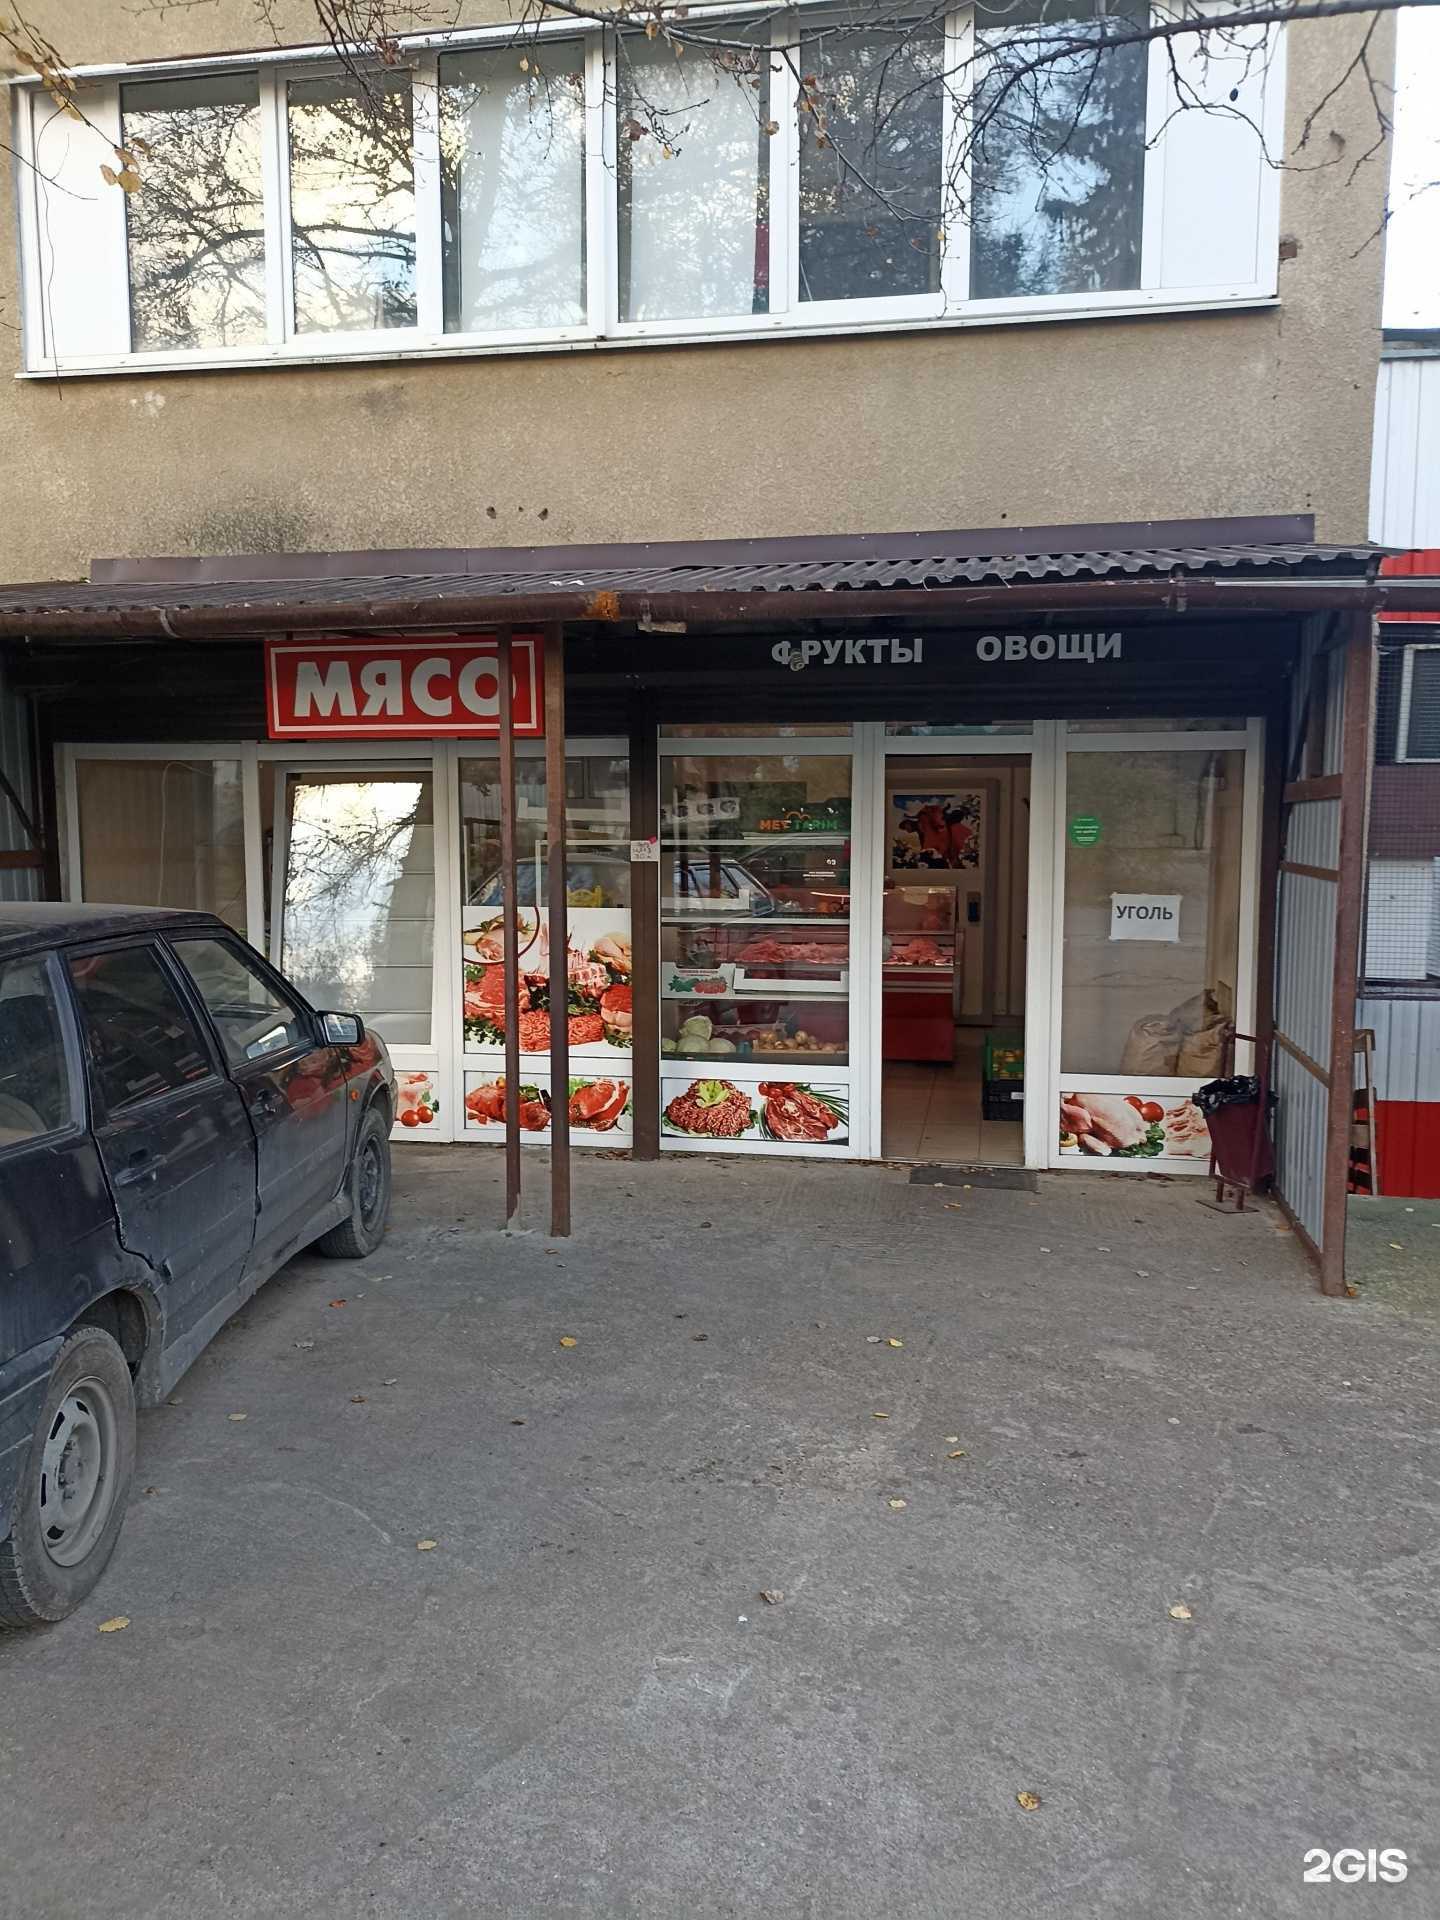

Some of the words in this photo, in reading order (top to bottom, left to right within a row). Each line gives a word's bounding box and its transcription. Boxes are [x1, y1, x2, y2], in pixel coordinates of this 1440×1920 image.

[771, 638, 923, 665] ФРУКТЫ
[976, 633, 1122, 663] ОВОЩИ
[294, 656, 517, 717] МЯСО
[1116, 905, 1173, 920] УГОЛЬ
